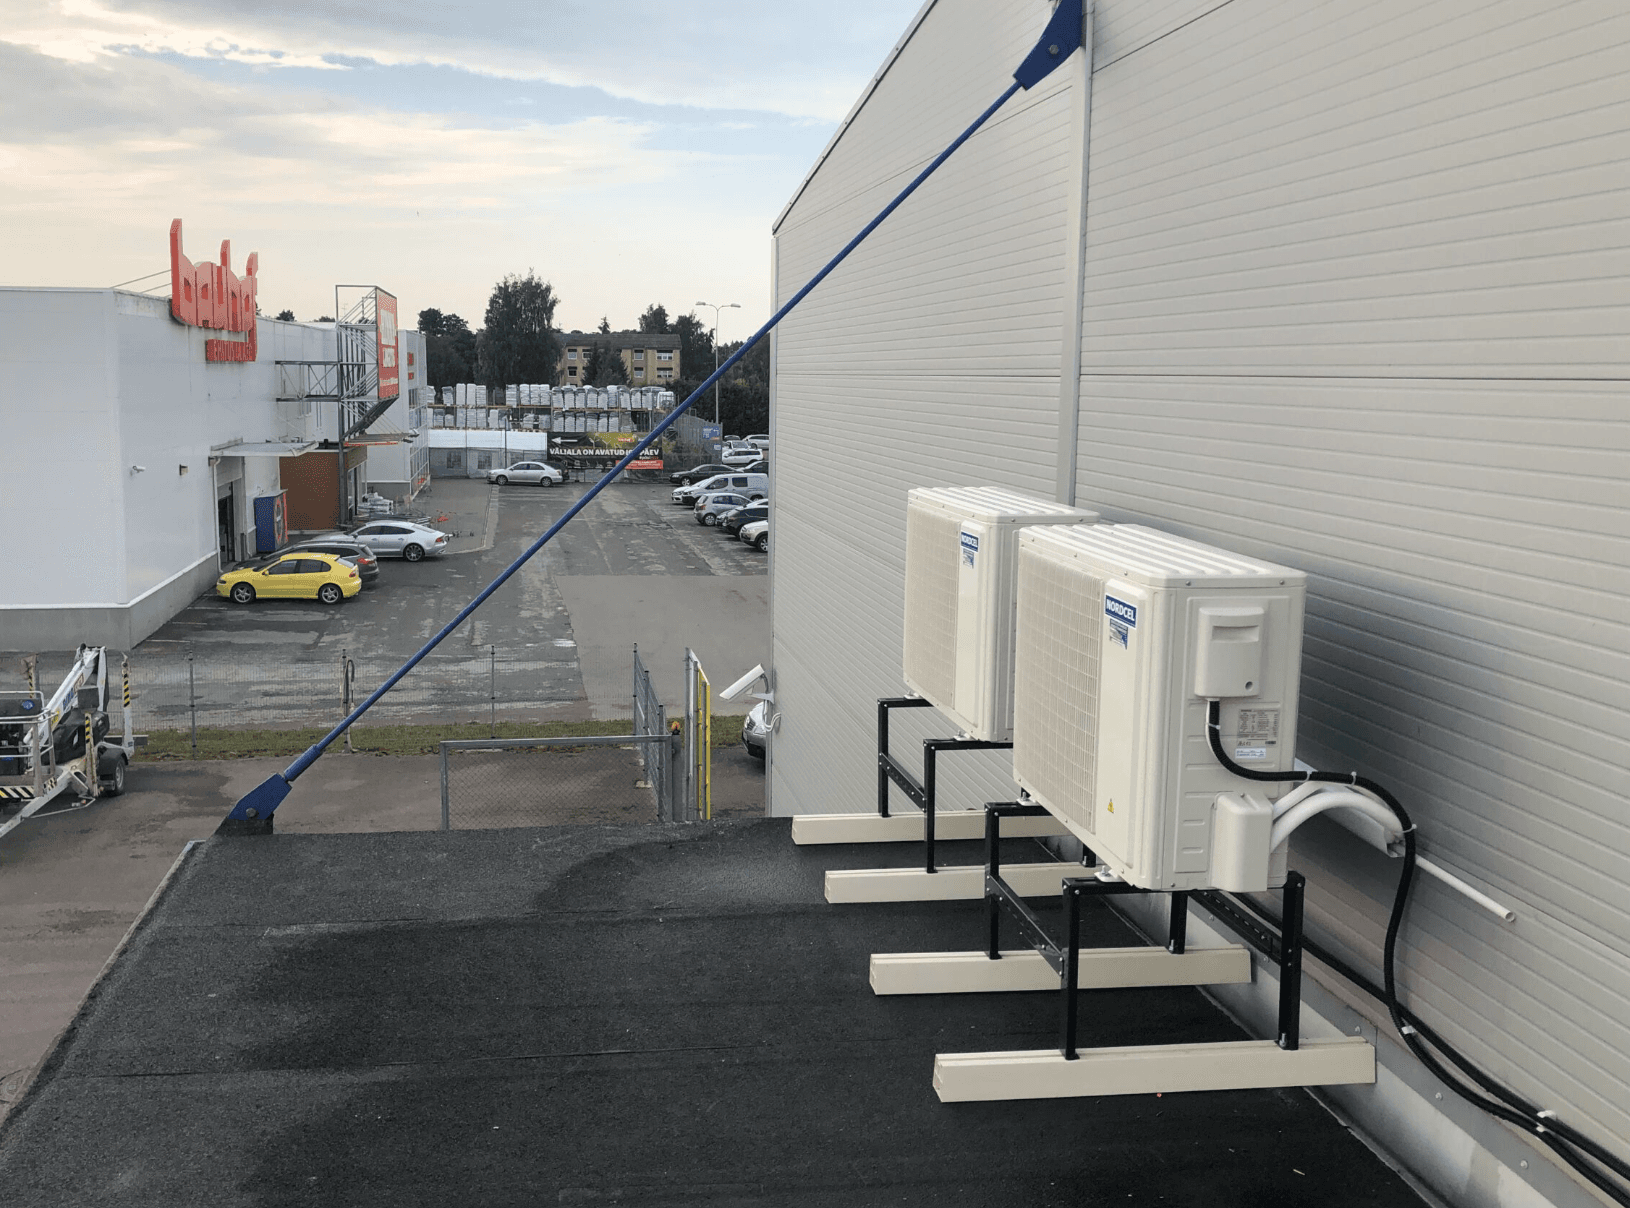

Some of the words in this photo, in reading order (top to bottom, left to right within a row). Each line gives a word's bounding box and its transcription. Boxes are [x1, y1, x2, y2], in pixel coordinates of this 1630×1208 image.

[582, 448, 594, 456] ON
[595, 448, 625, 456] AVATUD
[1106, 599, 1135, 621] NORDCEL
